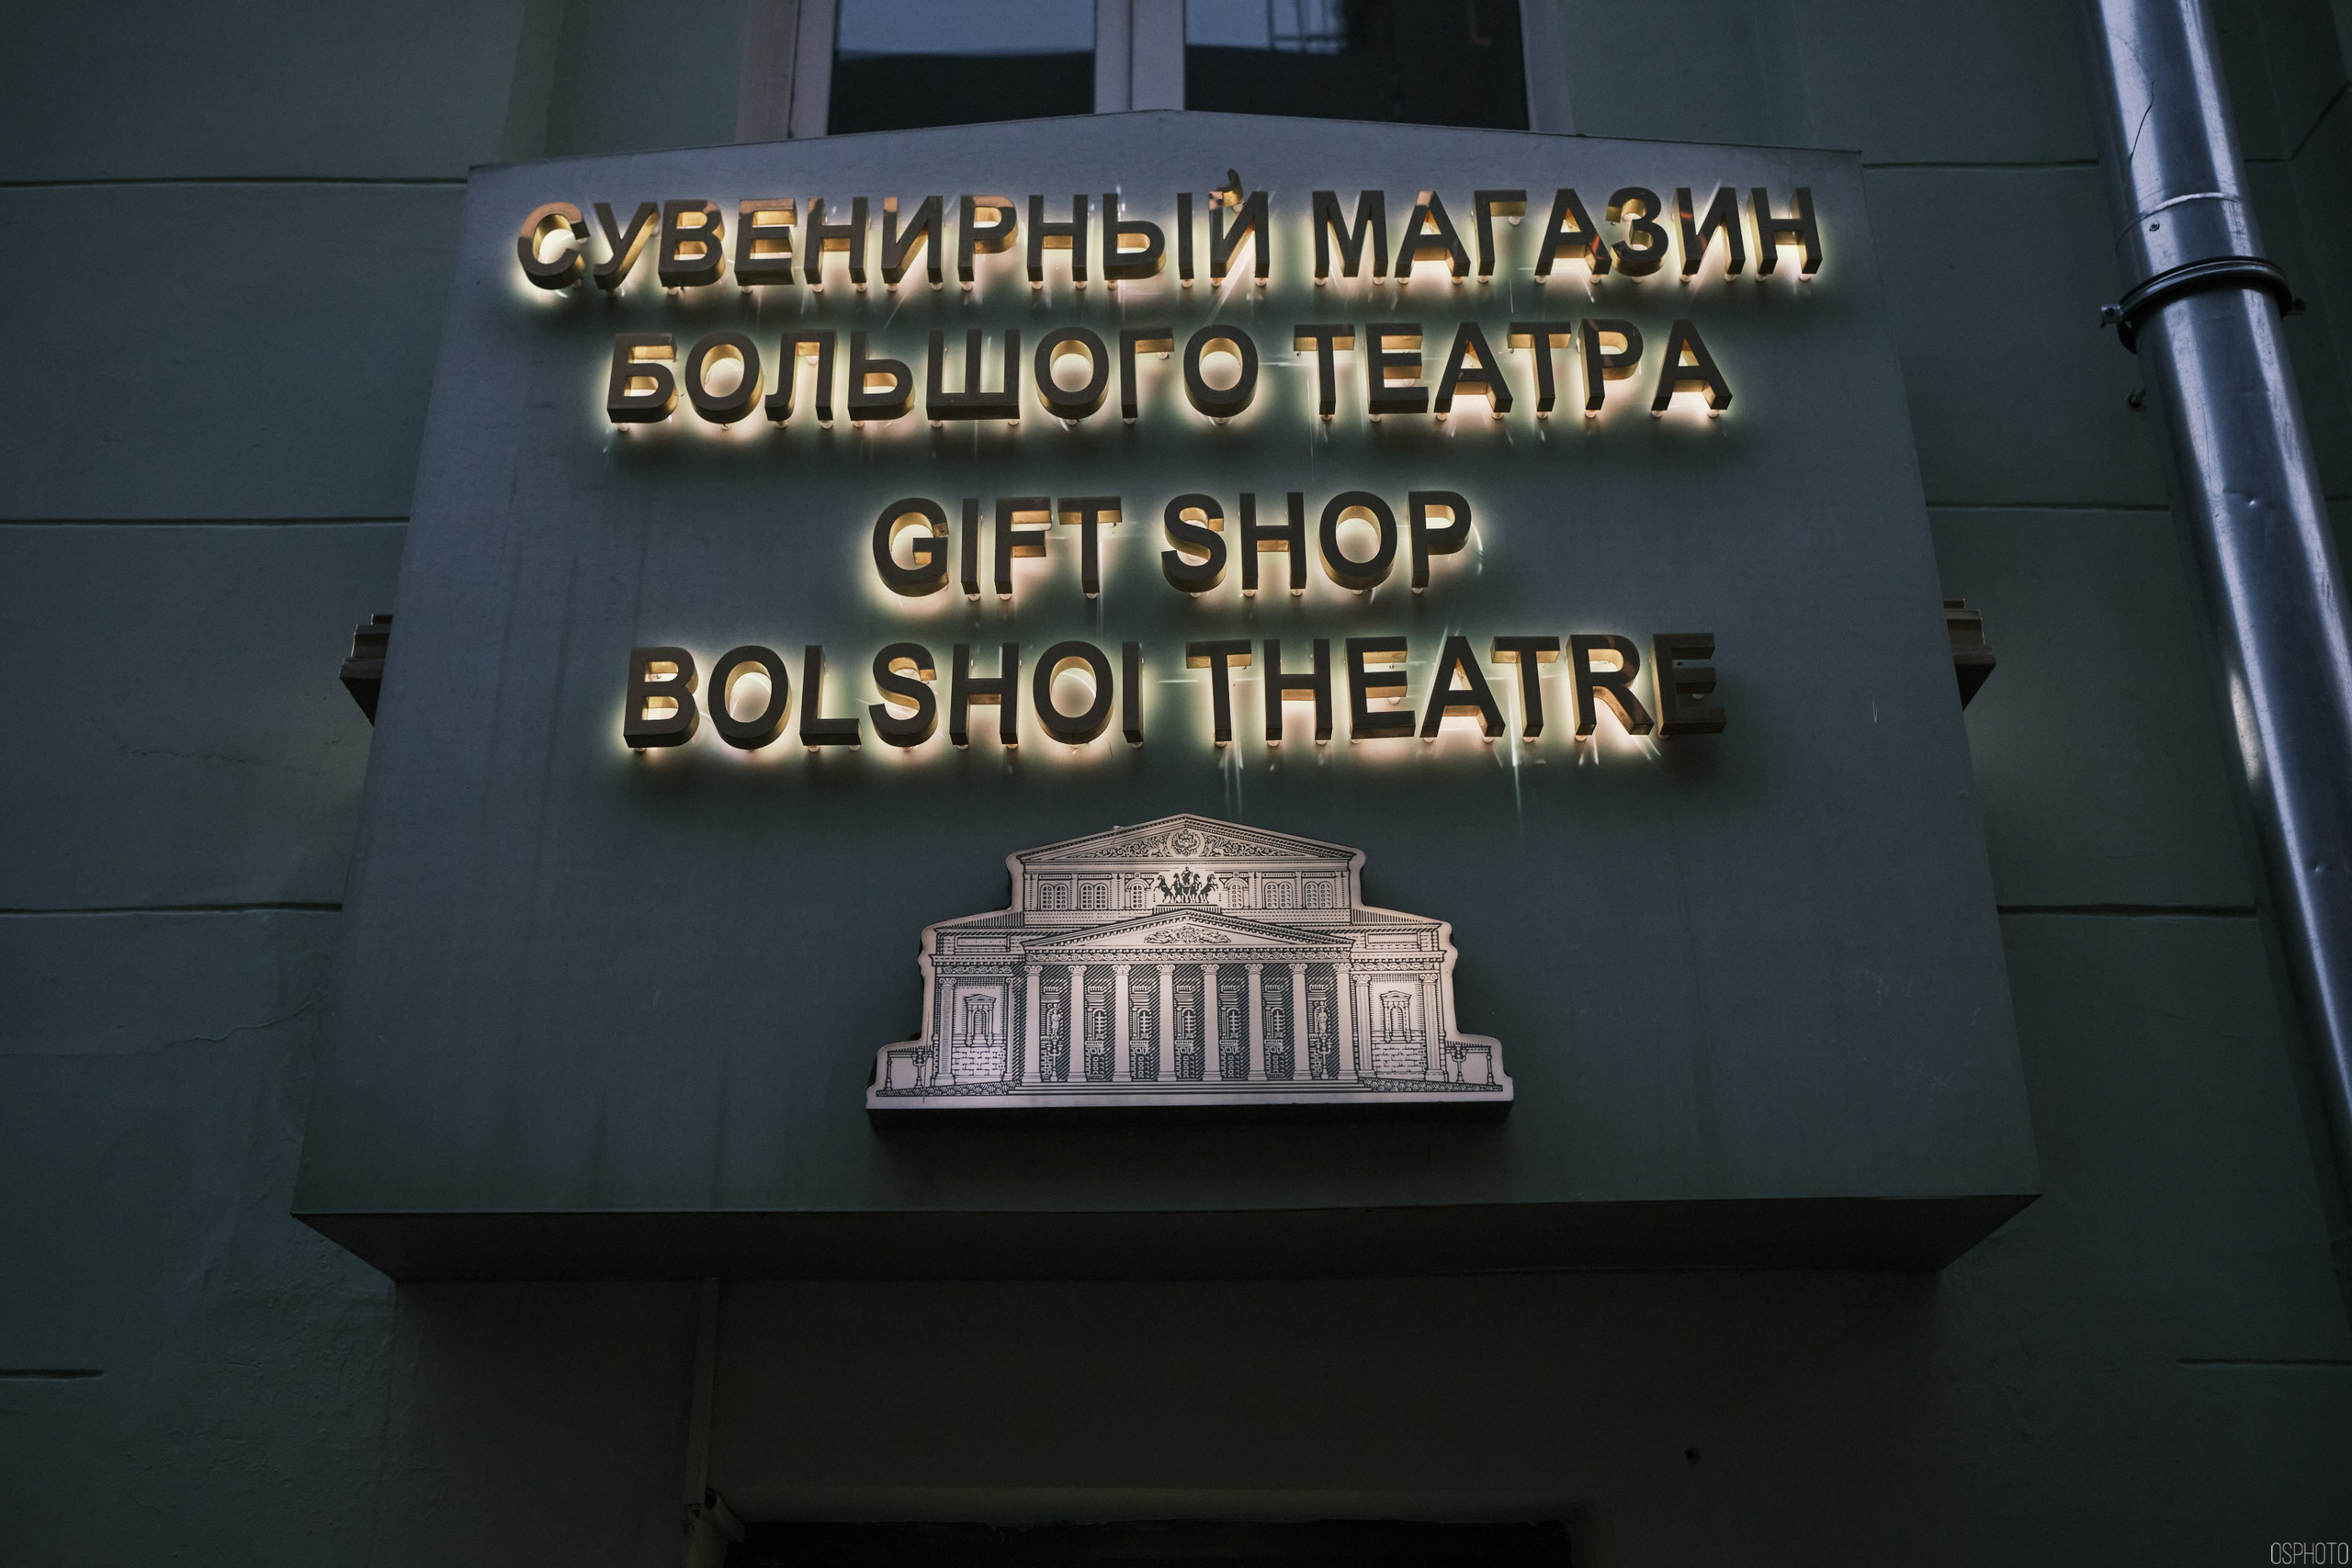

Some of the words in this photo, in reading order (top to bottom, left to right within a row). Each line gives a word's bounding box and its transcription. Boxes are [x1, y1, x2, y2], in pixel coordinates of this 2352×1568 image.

[517, 168, 1270, 289] СУВЕНИРНЫЙ
[1312, 186, 1822, 279] МАГАЗИН
[606, 325, 1259, 423] БОЛЬШОГО
[1294, 319, 1733, 414] ТЕАТРА
[872, 496, 1123, 597] GIFT
[1161, 491, 1472, 592] SHOP
[624, 641, 1143, 750] BOLSHOI
[1186, 633, 1725, 742] THEATRE
